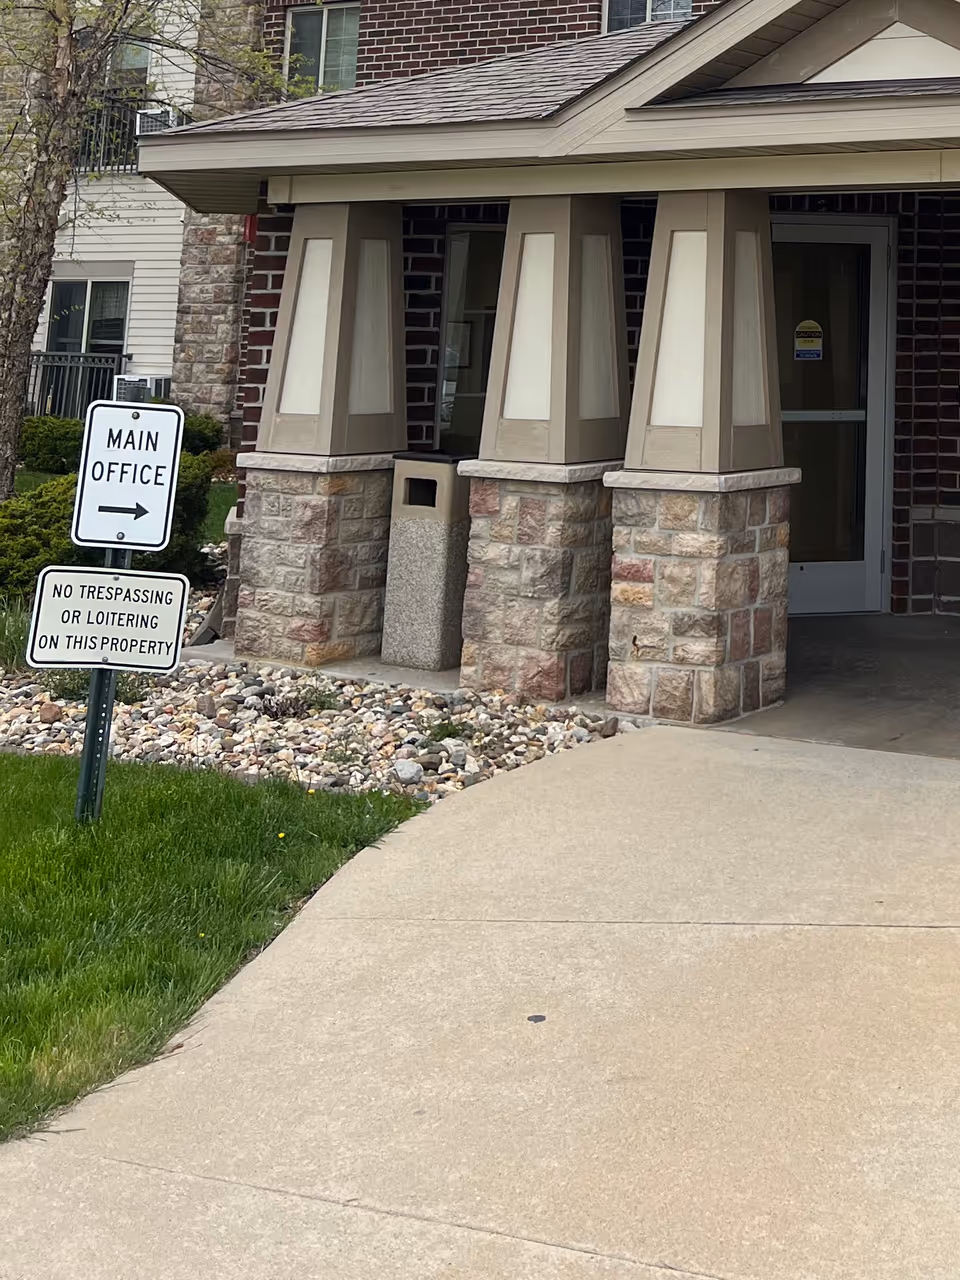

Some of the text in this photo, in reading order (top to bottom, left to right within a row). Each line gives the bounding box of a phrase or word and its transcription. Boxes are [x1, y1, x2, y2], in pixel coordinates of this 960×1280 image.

[107, 428, 159, 452] MAIN
[91, 461, 167, 486] OFFICE
[52, 584, 174, 606] NO TRESPASSING
[61, 609, 159, 630] OR LOITERING
[38, 634, 174, 656] ON THIS PROPERTY
